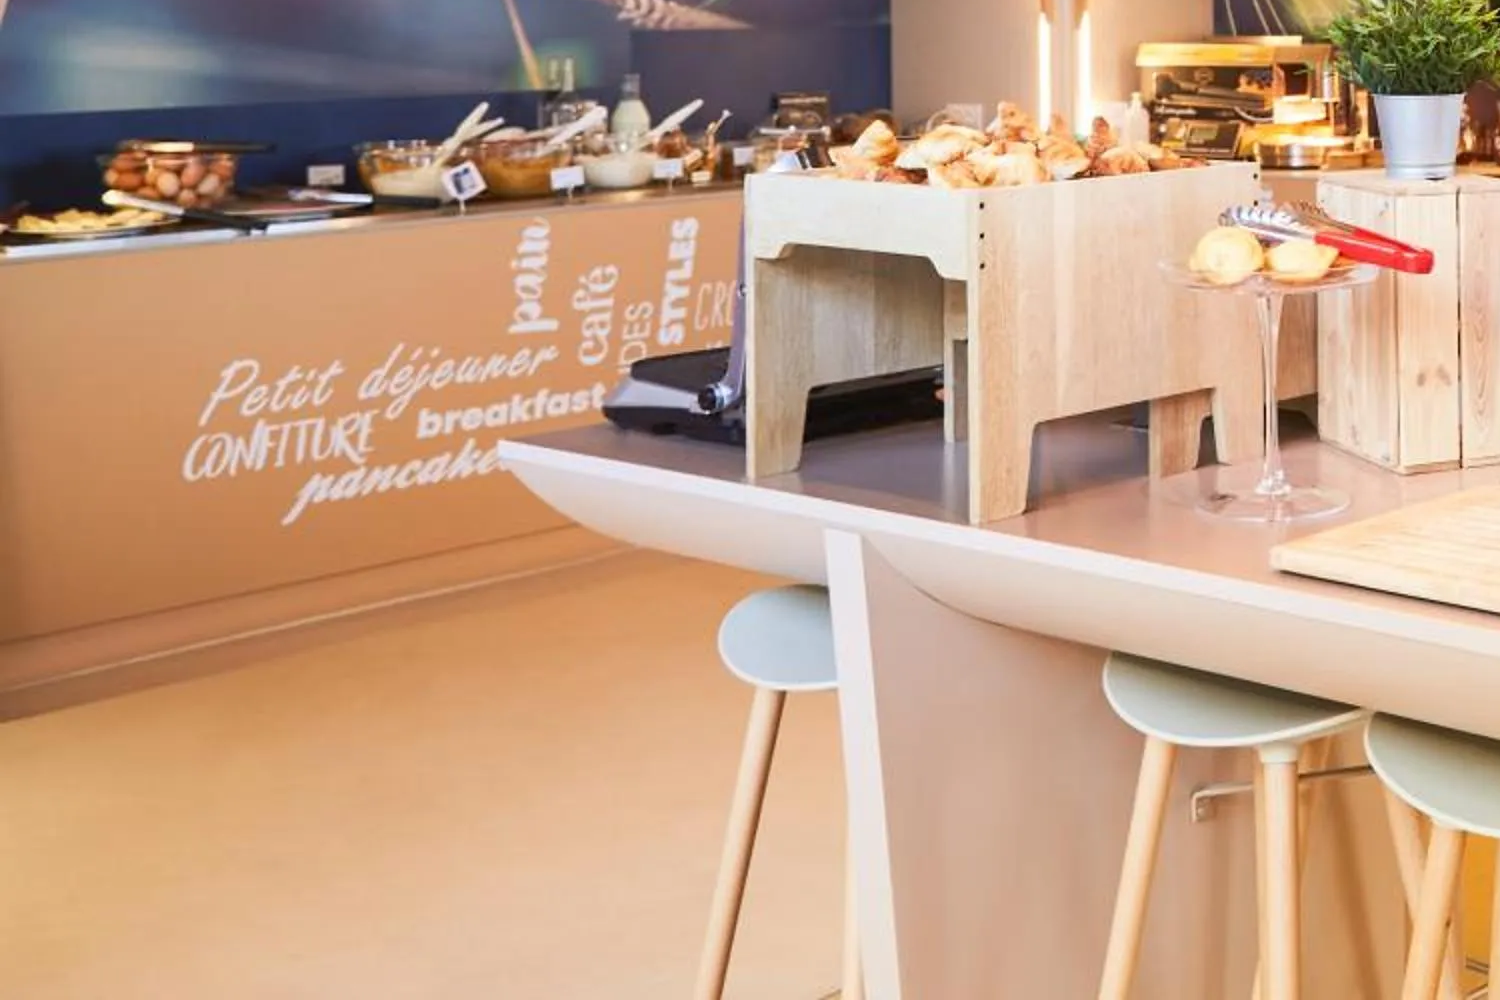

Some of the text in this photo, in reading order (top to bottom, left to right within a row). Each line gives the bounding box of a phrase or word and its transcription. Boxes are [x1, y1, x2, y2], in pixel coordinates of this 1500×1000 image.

[508, 215, 559, 334] pain
[571, 264, 619, 366] café
[657, 216, 699, 346] STYLES
[199, 343, 560, 427] Petit déjeuner
[416, 382, 607, 439] breakfast
[182, 409, 381, 482] CONFITURE
[281, 437, 508, 527] pancake
